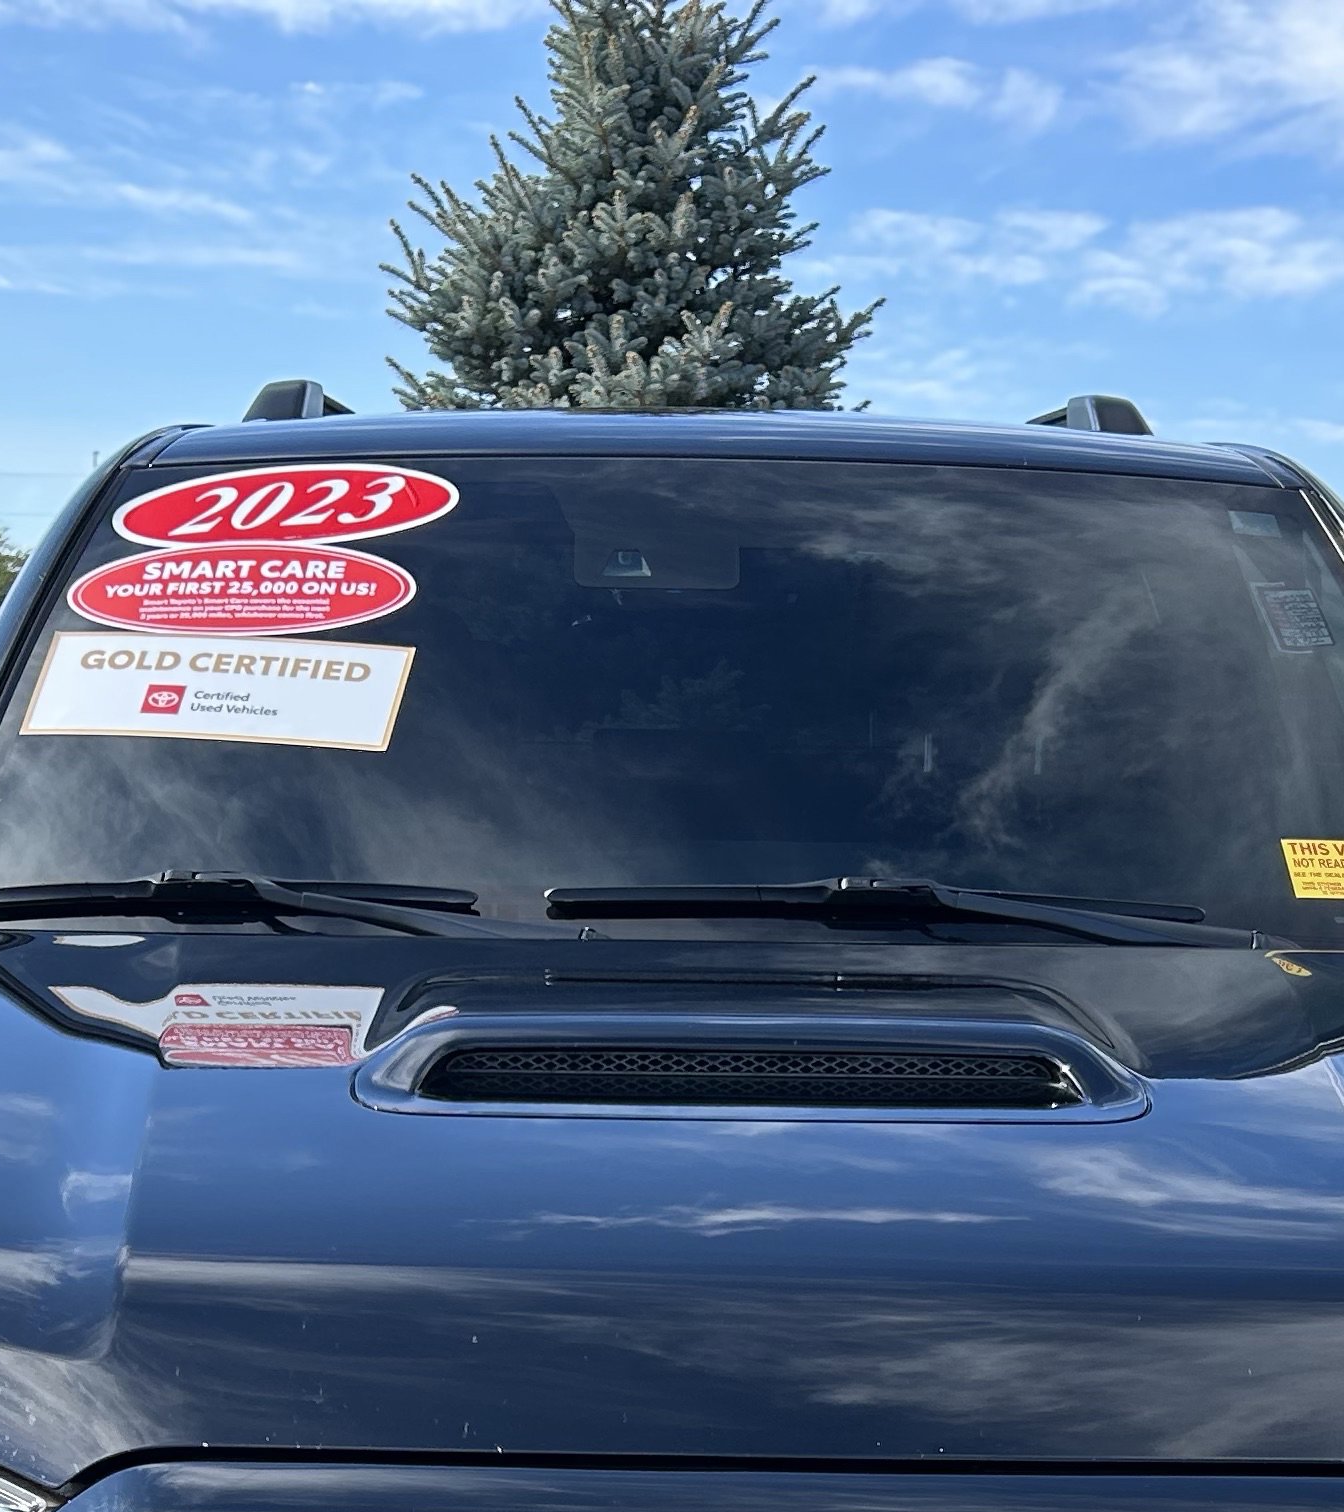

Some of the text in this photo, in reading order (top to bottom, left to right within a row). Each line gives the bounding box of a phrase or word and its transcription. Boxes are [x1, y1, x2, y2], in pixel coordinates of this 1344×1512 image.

[167, 474, 408, 537] 2023
[142, 560, 347, 581] SMART CARE
[105, 581, 378, 598] YOUR FIRST 25,000 ON US!
[80, 649, 372, 683] GOLD CERTIFIED
[193, 690, 251, 702] Certified
[190, 702, 278, 716] Used Vehicles
[1287, 842, 1330, 856] THIS
[1293, 858, 1316, 869] NOT
